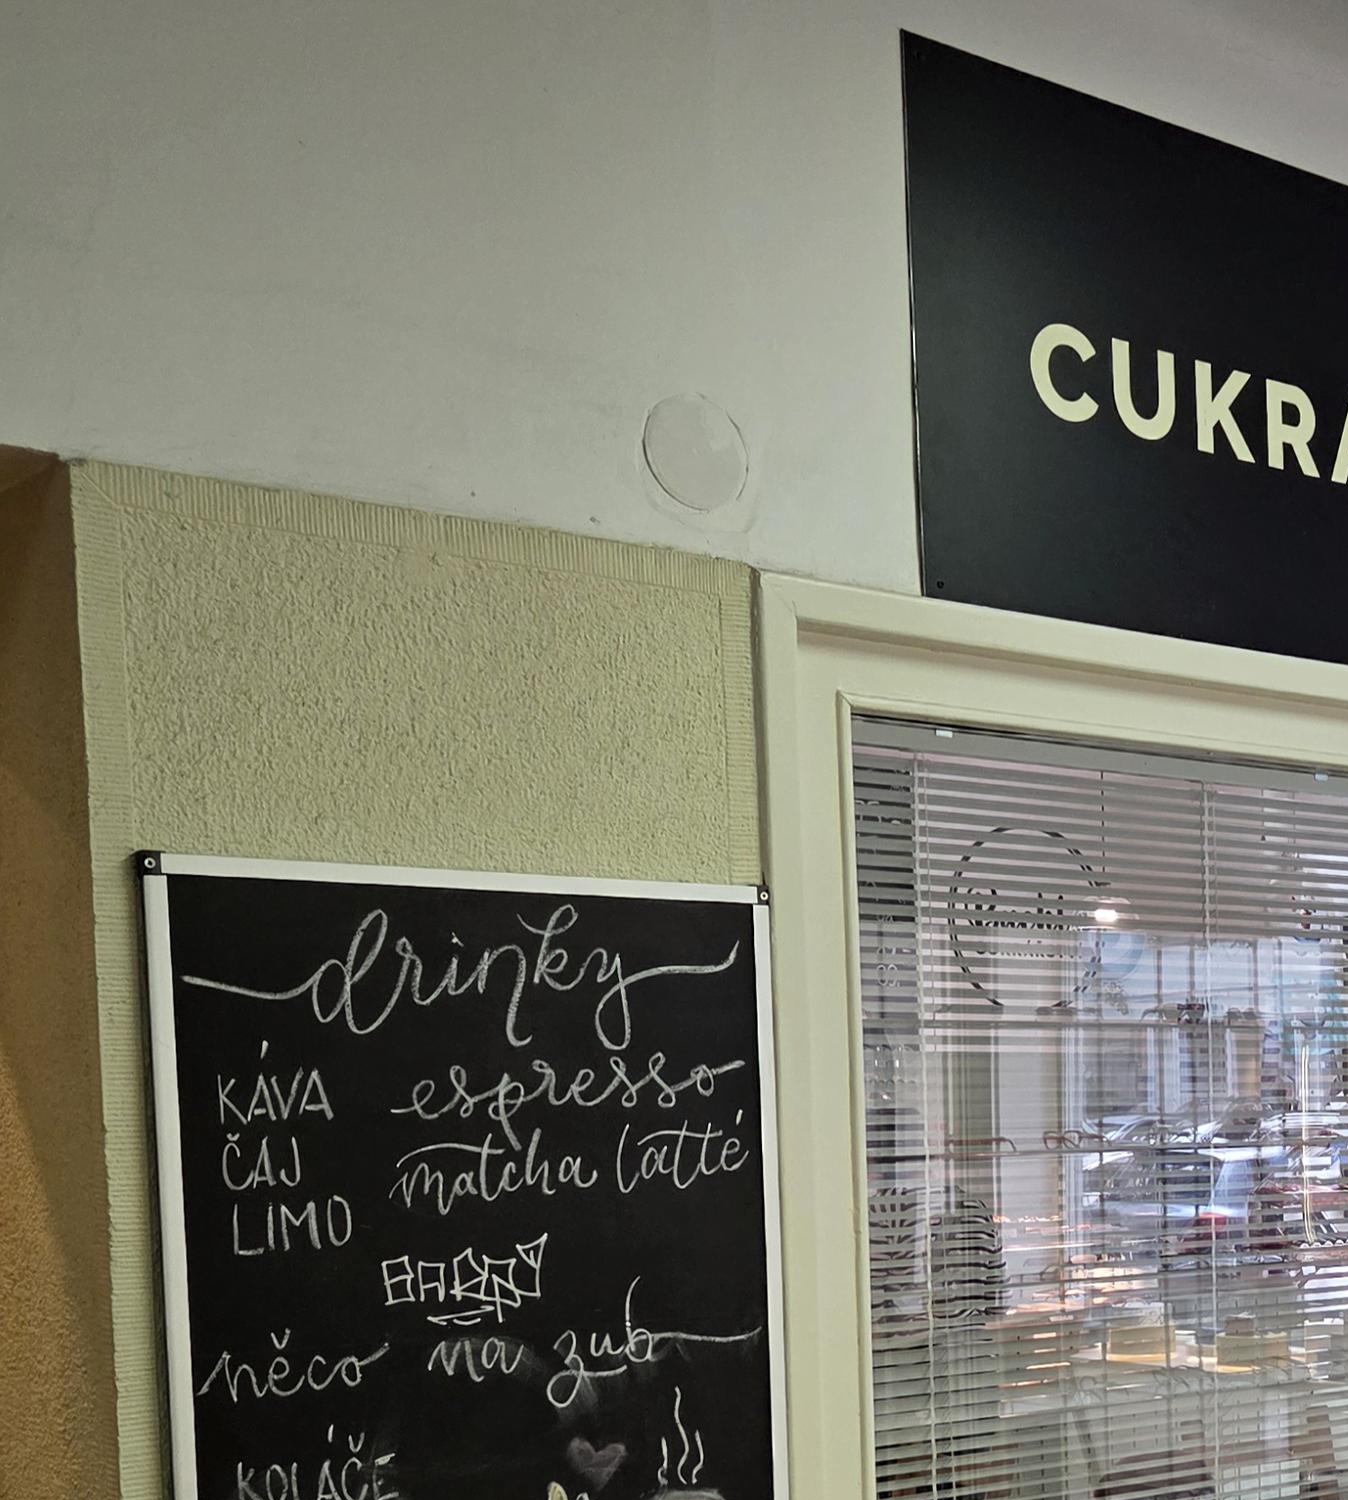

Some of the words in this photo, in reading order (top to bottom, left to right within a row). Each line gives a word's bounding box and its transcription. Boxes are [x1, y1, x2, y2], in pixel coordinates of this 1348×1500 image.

[181, 904, 740, 1050] drinky
[217, 1040, 334, 1126] KÁVA
[390, 1051, 747, 1150] espresso
[221, 1133, 302, 1190] ČAJ
[389, 1128, 598, 1216] matcha
[232, 1194, 354, 1257] LIMO
[195, 1327, 390, 1402] něco
[427, 1335, 525, 1382] na
[546, 1275, 763, 1408] zub
